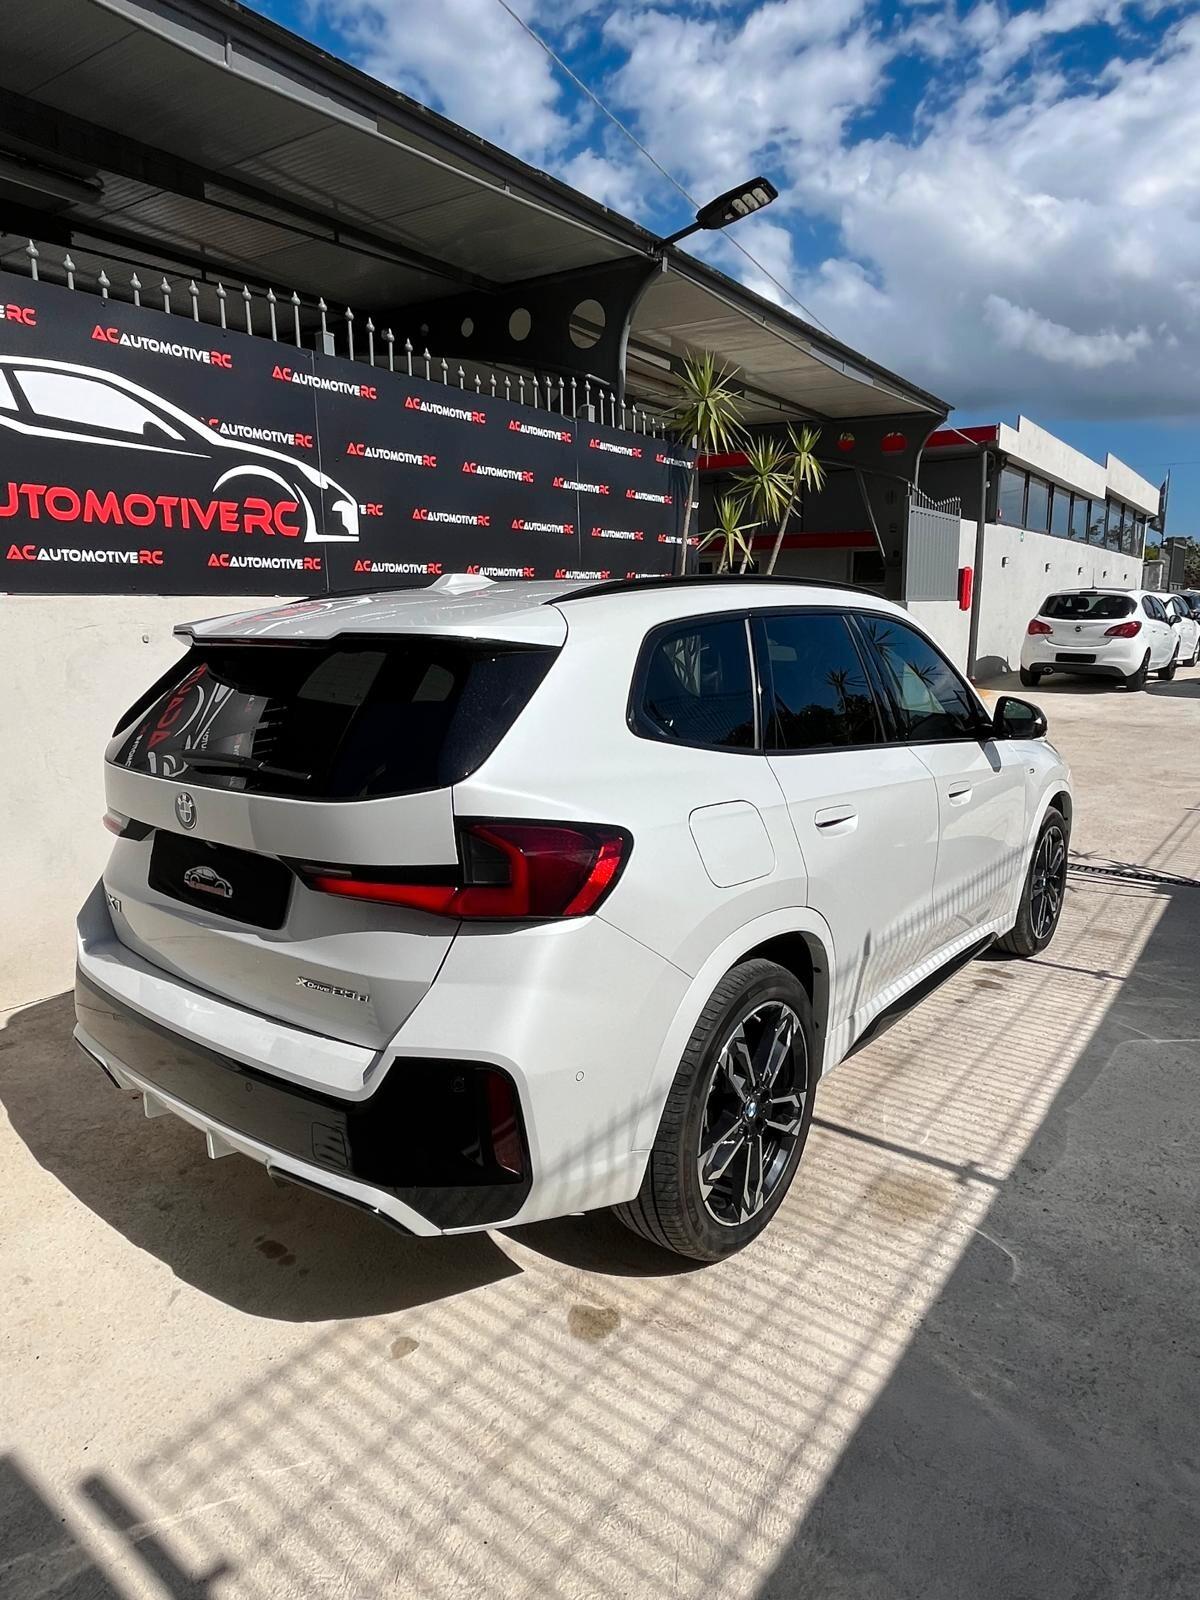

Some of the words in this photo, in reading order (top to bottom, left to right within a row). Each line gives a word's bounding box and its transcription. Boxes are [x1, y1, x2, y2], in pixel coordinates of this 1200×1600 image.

[91, 325, 233, 369] ACAUTOMOTIVERC
[272, 366, 377, 400] ACAUTOMOTIVERC
[405, 396, 486, 424] ACAUTOMOTIVERC
[508, 420, 572, 443] ACAUTOMOTIVERC
[347, 442, 437, 468] ACAUTOMOTIVERC
[589, 438, 642, 458] ACAUTOMOTIVERC
[462, 461, 534, 484] ACAUTOMOTIVERC
[552, 477, 611, 495] ACAUTOMOTIVERC
[413, 508, 491, 527] ACAUTOMOTIVERC
[511, 518, 574, 536] ACAUTOMOTIVERC
[591, 526, 644, 542] ACAUTOMOTIVERC
[6, 544, 164, 566] ACAUTOMOTIVERC
[208, 553, 322, 571] ACAUTOMOTIVERC
[354, 559, 443, 576] ACAUTOMOTIVERC
[466, 564, 536, 578] ACAUTOMOTIVERC
